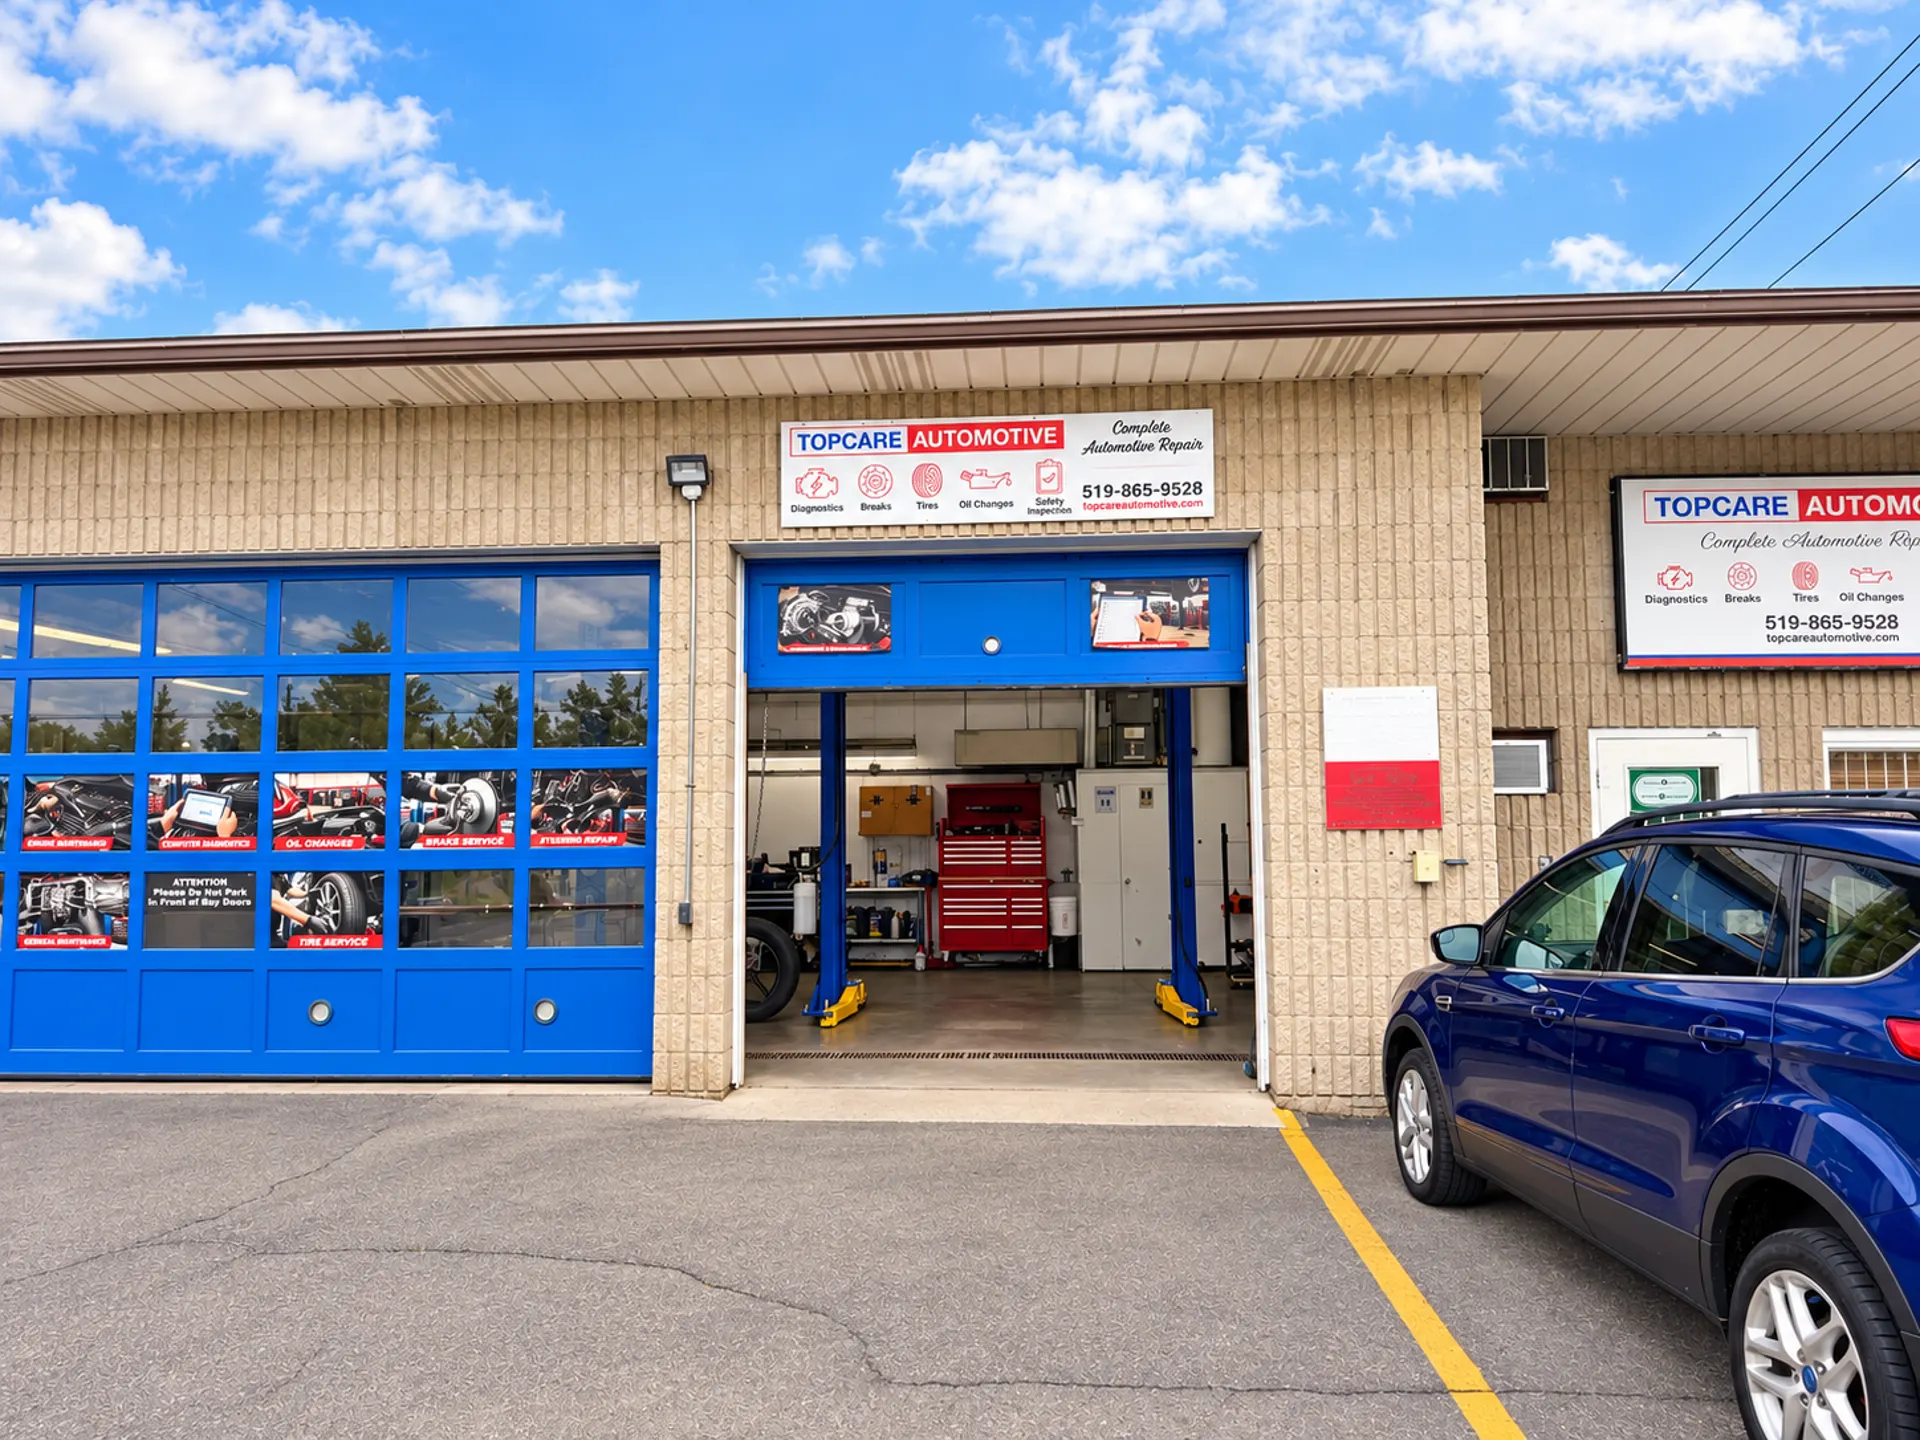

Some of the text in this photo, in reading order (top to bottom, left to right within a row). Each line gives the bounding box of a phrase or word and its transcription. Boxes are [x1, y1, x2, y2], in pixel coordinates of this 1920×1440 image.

[1112, 419, 1172, 437] Complete
[797, 426, 1058, 451] TOPCARE AUTOMOTIVE
[1081, 436, 1204, 456] Automotive Repair
[1082, 481, 1203, 499] 519-865-9528
[860, 502, 892, 511] Breaks
[916, 501, 939, 510] Tires
[959, 499, 1014, 509] Oil Changes
[1035, 496, 1064, 507] Safety
[1083, 499, 1204, 512] topcareautomotive.com
[1654, 496, 1789, 518] TOPCARE
[791, 503, 844, 513] Diagnostics
[1700, 531, 1777, 553] Complete
[1782, 530, 1884, 548] Automotive
[1645, 595, 1708, 606] Diagnostics
[1725, 594, 1761, 603] Breaks
[1793, 593, 1819, 602] Tires
[1839, 591, 1904, 603] Oil Changes
[1765, 614, 1899, 631] 519-865-9528
[1766, 632, 1899, 643] topcareautomotive.com
[425, 838, 460, 846] BRAKE
[172, 878, 228, 887] ATTENTION
[153, 888, 186, 896] Please
[225, 887, 247, 896] Park
